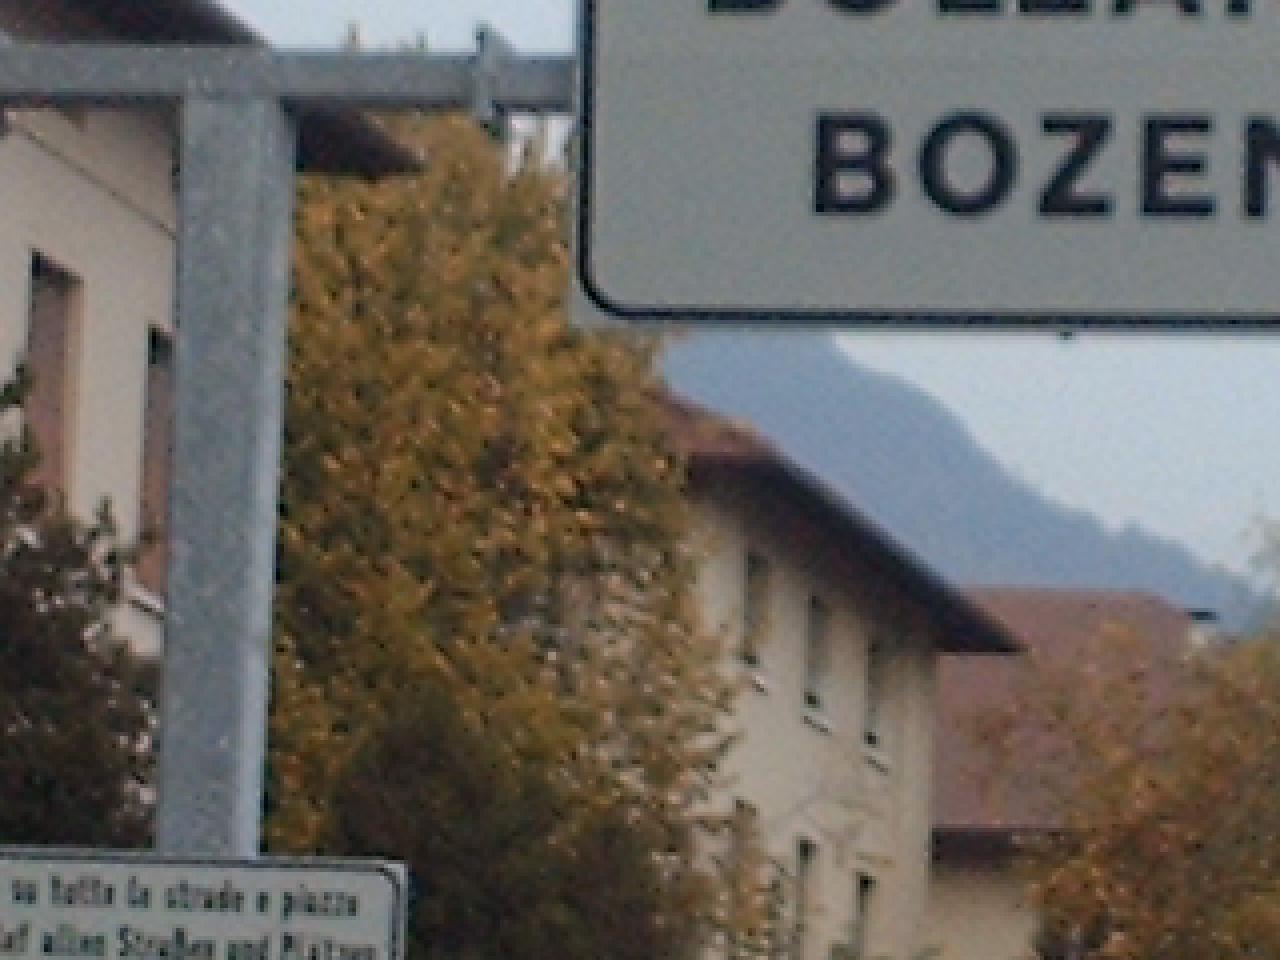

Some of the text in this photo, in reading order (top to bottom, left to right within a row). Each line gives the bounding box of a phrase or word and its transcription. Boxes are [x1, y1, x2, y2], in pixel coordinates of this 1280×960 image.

[164, 879, 244, 913] strade
[256, 890, 269, 914] e
[40, 923, 105, 958] allen
[118, 923, 216, 960] Straßen
